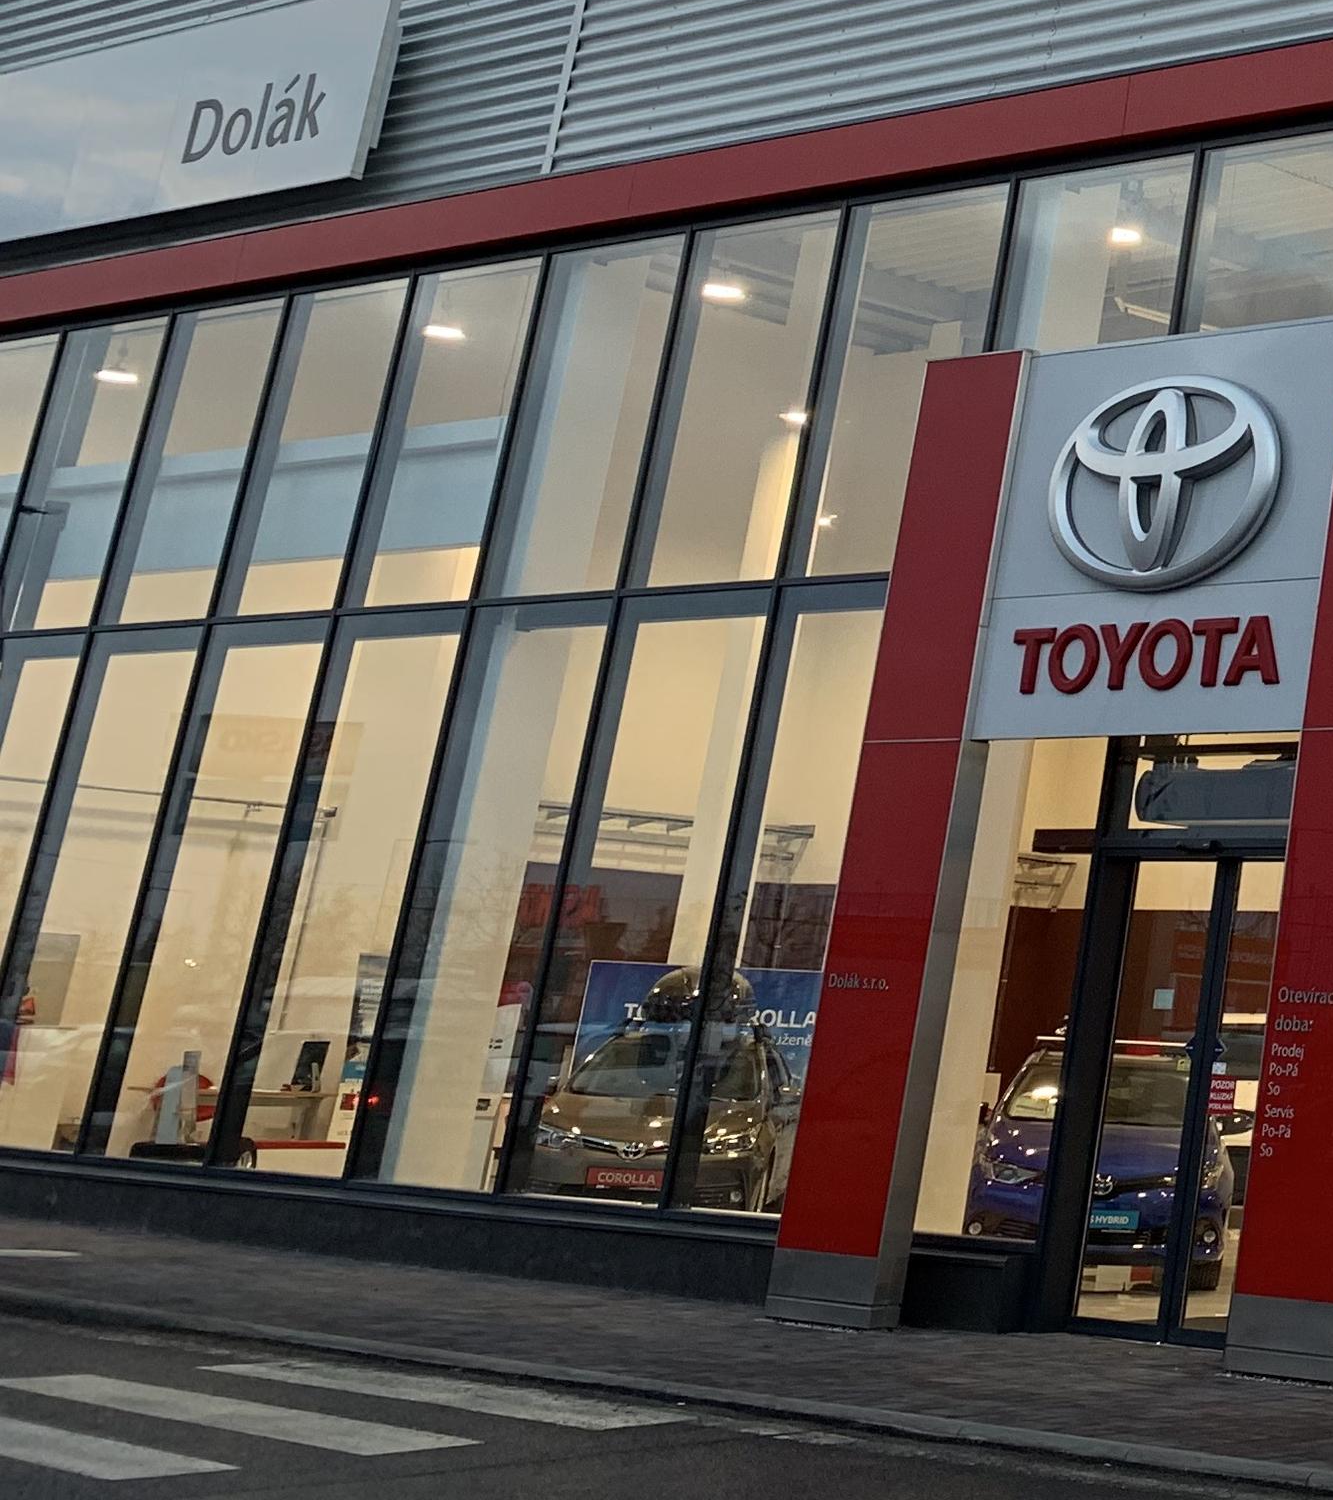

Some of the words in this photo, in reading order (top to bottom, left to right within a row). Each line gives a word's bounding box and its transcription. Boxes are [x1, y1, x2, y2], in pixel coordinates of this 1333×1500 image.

[181, 73, 326, 164] Dolák
[1013, 615, 1280, 695] TOYOTA
[828, 972, 860, 989] Dolák
[863, 977, 889, 990] s.r.o.
[1274, 1014, 1313, 1032] doba:
[1271, 1042, 1305, 1061] Prodej
[1269, 1062, 1298, 1077] Po-Pá
[1267, 1081, 1280, 1095] So
[1264, 1104, 1295, 1119] Servis
[1262, 1123, 1291, 1138] Po-Pá
[1260, 1143, 1273, 1156] So
[598, 1172, 656, 1186] COROLLA
[1095, 1215, 1129, 1225] HYBRID
